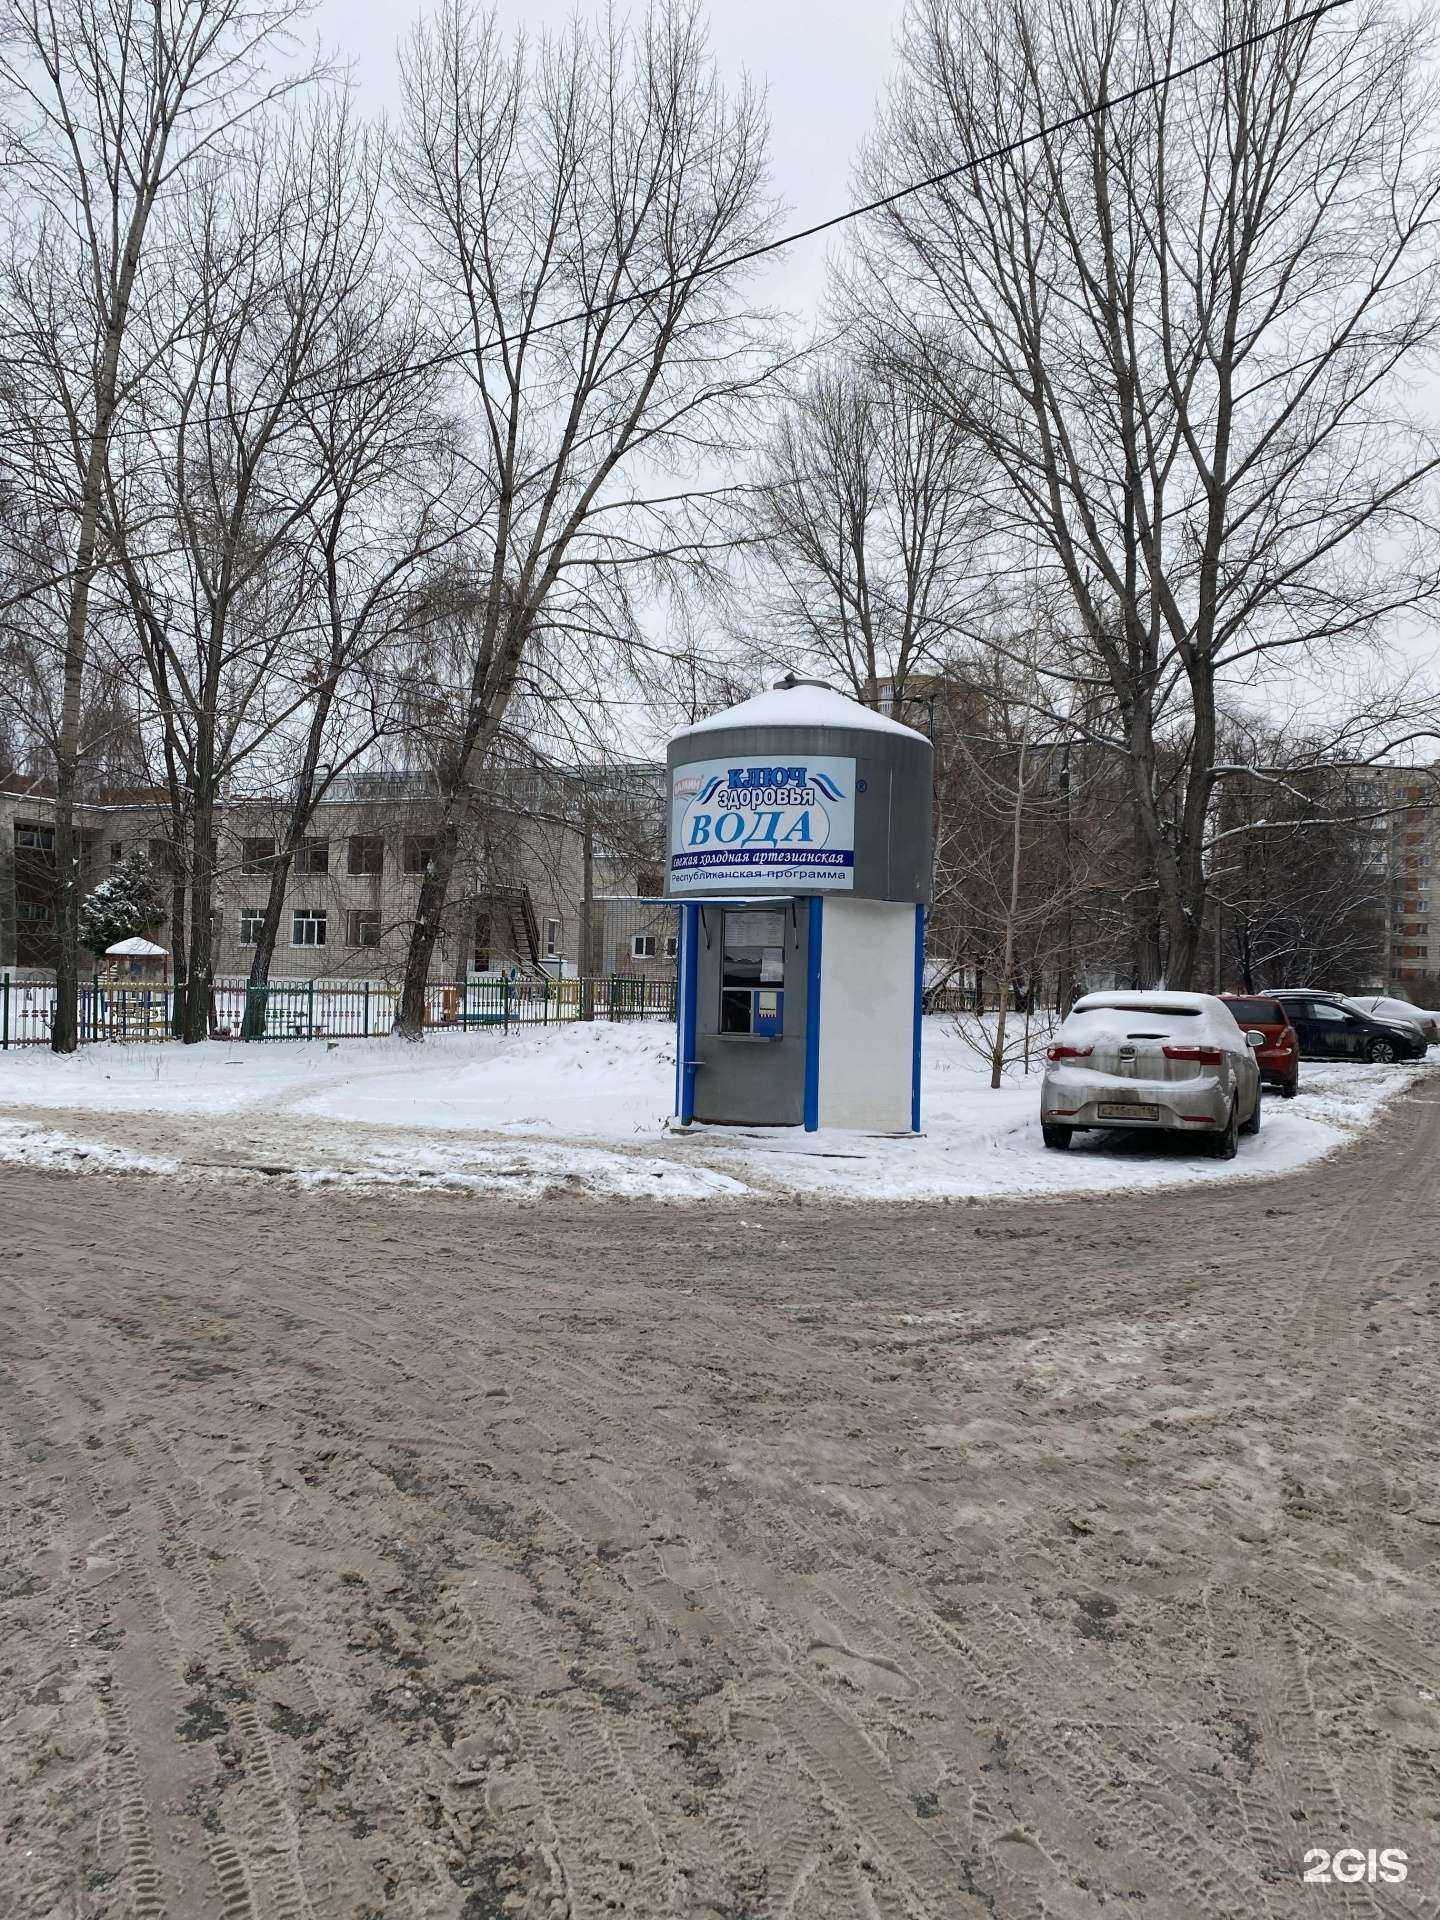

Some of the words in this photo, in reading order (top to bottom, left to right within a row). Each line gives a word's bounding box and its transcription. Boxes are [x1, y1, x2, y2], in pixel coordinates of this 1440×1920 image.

[728, 767, 807, 789] КЛЮЧ
[718, 788, 814, 809] ЗДОРОВЬЯ
[688, 810, 813, 848] ВОДА
[700, 850, 749, 865] холодная
[752, 851, 844, 867] артезианская
[672, 870, 762, 885] Республиканская
[767, 869, 846, 881] программа
